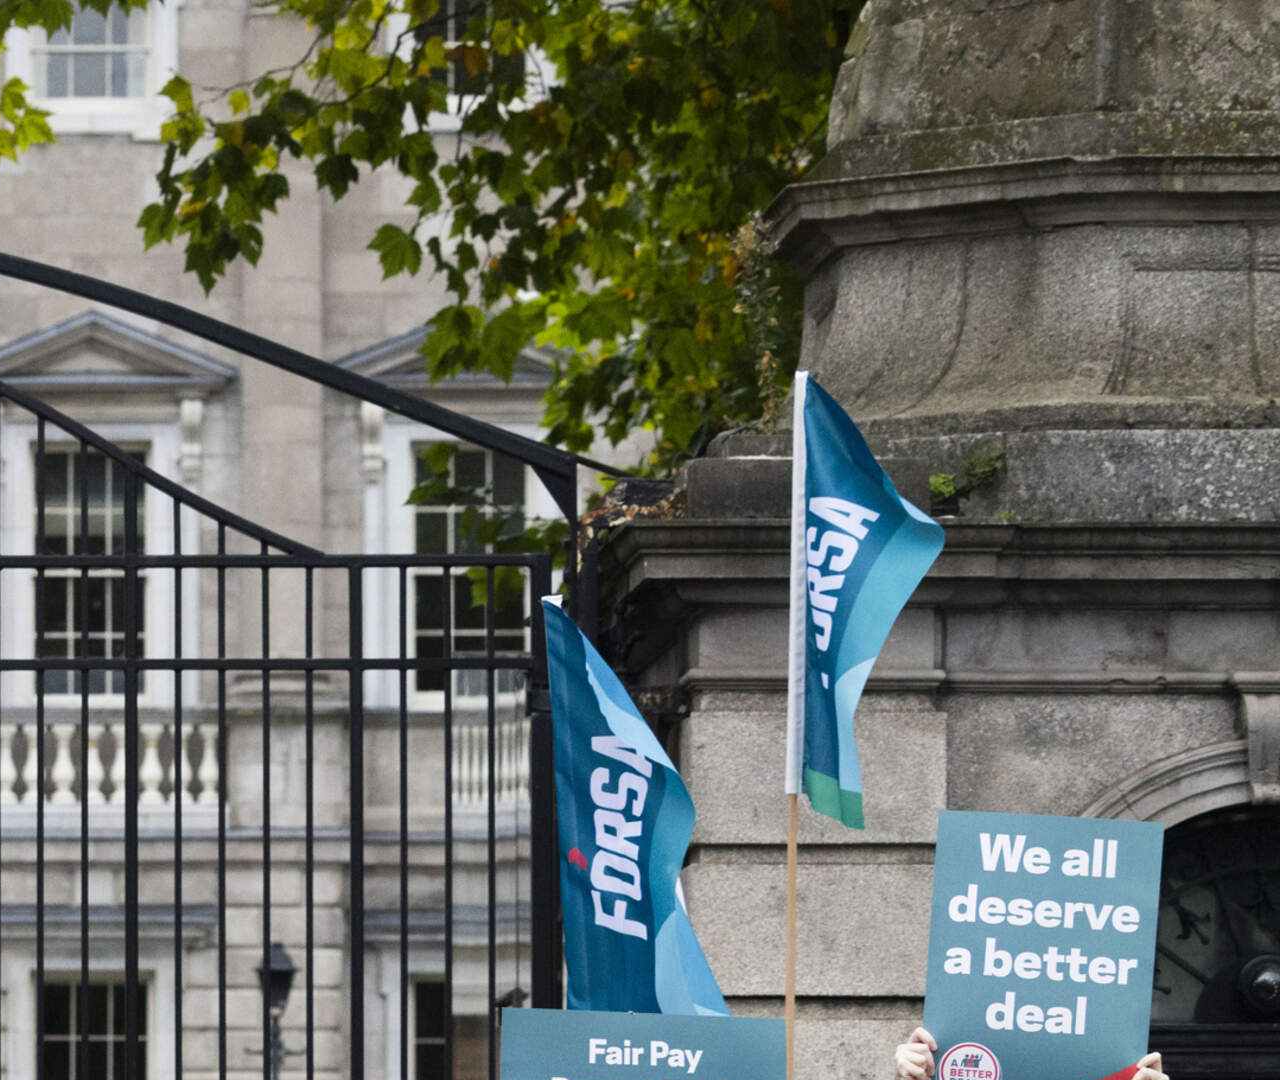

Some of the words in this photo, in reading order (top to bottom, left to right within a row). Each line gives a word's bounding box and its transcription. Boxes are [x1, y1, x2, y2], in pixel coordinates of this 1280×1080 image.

[568, 735, 653, 940] FÓRSA
[979, 832, 1051, 875] We
[1061, 838, 1118, 878] all
[948, 884, 1140, 933] deserve
[943, 947, 971, 975] a
[983, 937, 1138, 985] better
[985, 991, 1087, 1035] deal
[589, 1038, 644, 1066] Fair
[650, 1040, 703, 1073] Pay
[950, 1069, 992, 1079] BETTER
